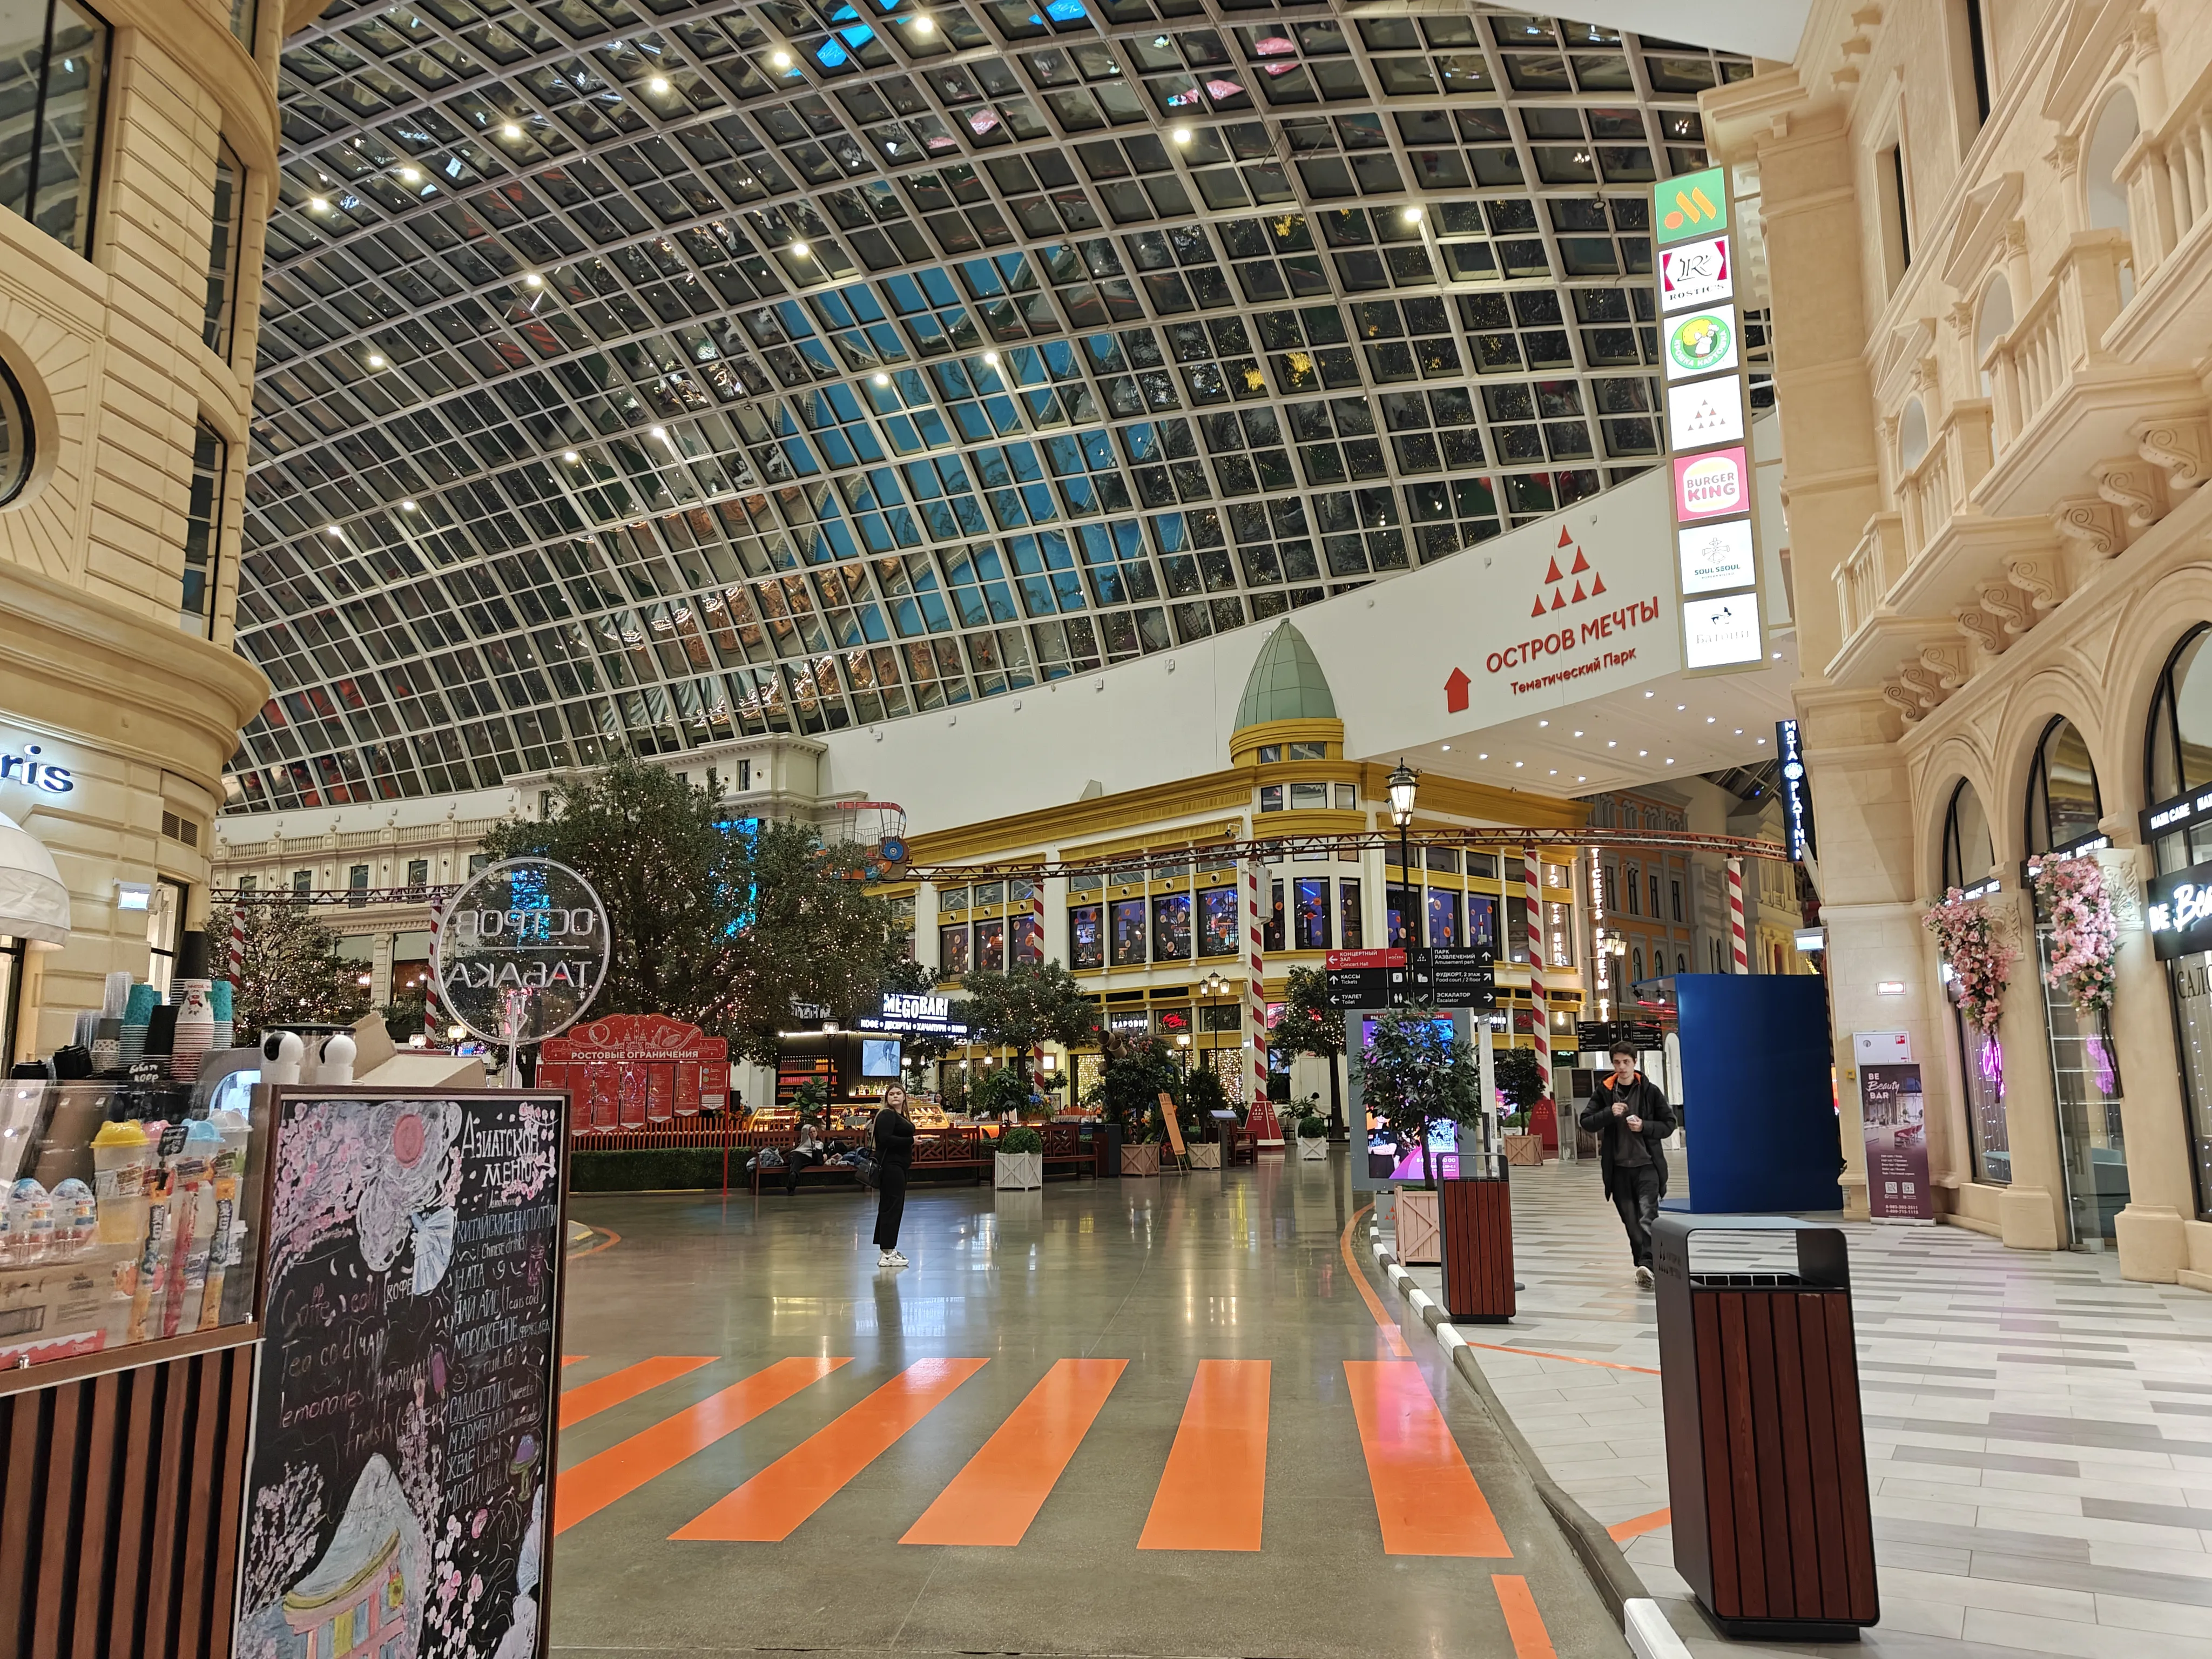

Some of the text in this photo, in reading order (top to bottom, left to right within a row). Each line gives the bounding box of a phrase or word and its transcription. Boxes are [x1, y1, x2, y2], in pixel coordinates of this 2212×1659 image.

[1674, 328, 1728, 367] КРОШКА КАРТОШКА
[1687, 472, 1735, 489] BURGER
[1688, 482, 1736, 502] KING
[1694, 564, 1741, 576] SOUL SEOUL
[1486, 596, 1660, 673] ОСТРОВ МЕЧТЫ
[1510, 647, 1637, 696] Тематический Парк
[1784, 720, 1798, 761] МЯТА
[1591, 848, 1604, 920] TICKETS
[883, 993, 948, 1019] MEGOBARI
[860, 1019, 967, 1034] КОФЕ ДЕСЕРТЫ ХАЧАПУРИ ВИНО
[1111, 1019, 1149, 1029] ЖАРОВНЯ
[571, 1050, 699, 1060] РОСТОВЫЕ ОГРАНИЧЕНИЯ
[1865, 1080, 1900, 1095] Beauty
[481, 1158, 534, 1188] МЕНЮ
